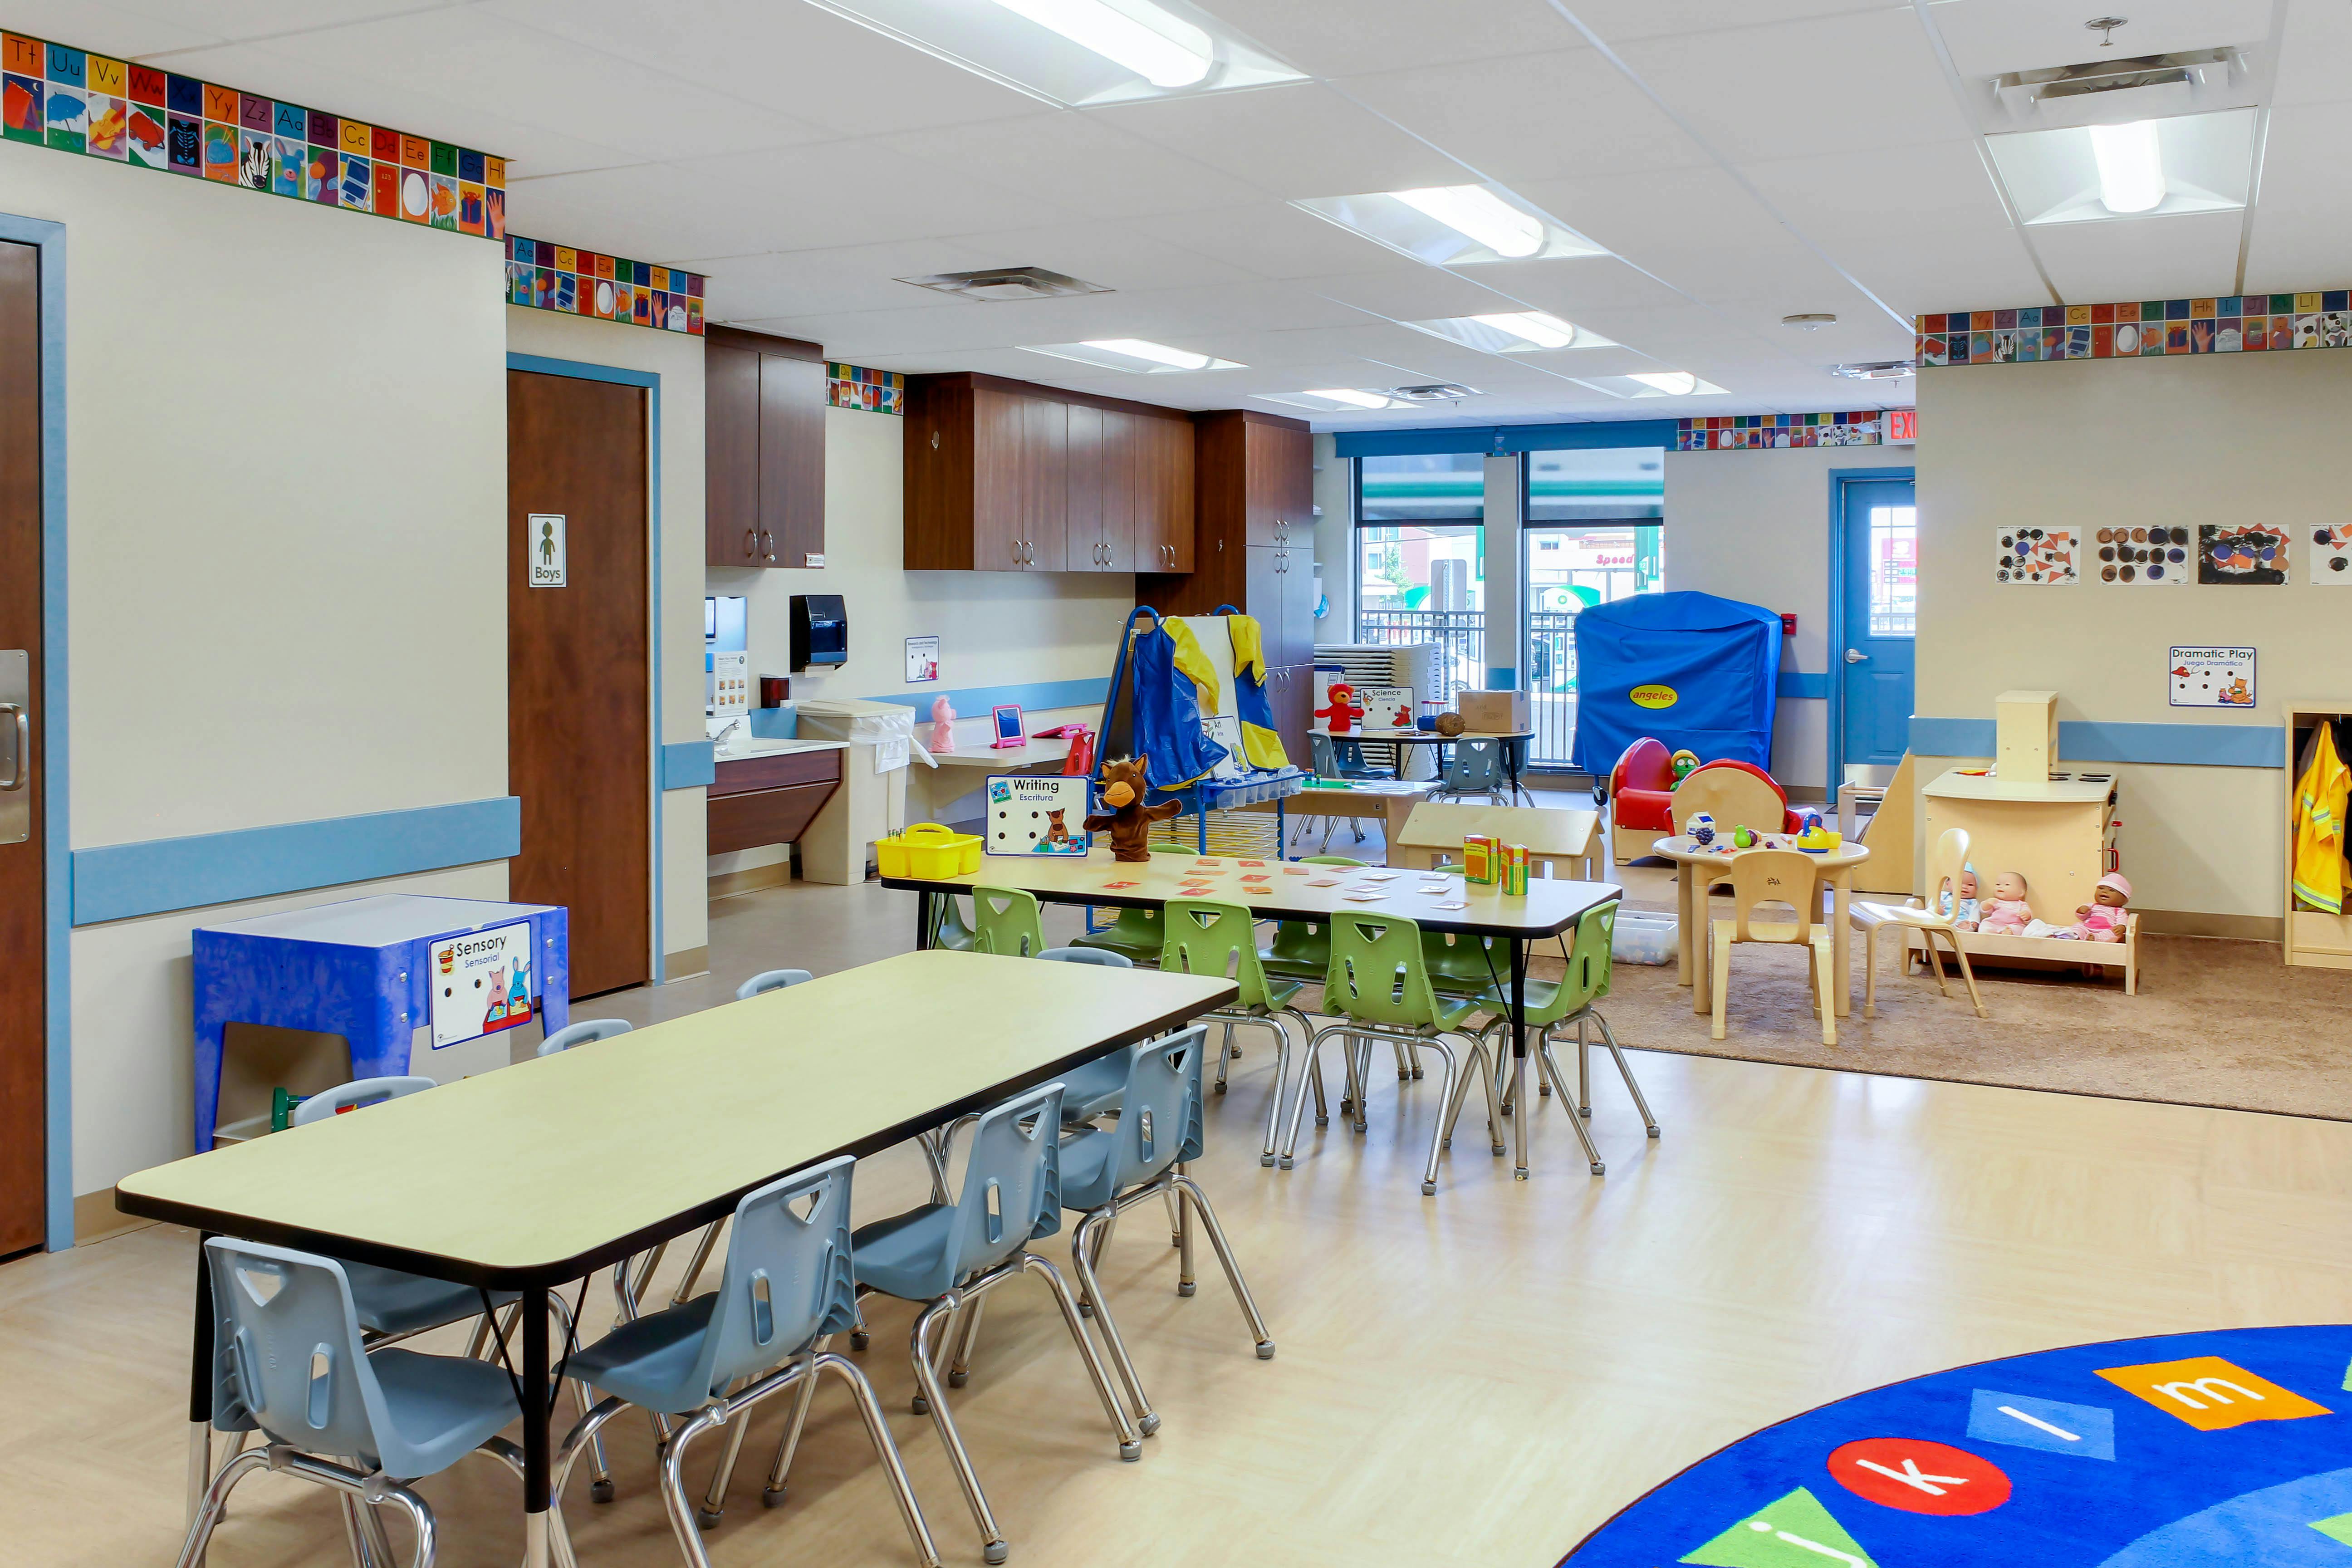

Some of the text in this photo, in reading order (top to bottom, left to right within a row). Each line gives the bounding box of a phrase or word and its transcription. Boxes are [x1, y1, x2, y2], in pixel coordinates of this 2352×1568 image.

[10, 39, 36, 65] Tt
[53, 50, 80, 76] Uu
[96, 60, 119, 85] Vv
[129, 70, 164, 96] Ww
[173, 80, 196, 104] Xx
[209, 89, 233, 122] Yy
[245, 98, 266, 122] Zz
[277, 109, 303, 131] Aa
[313, 116, 335, 138] Bb
[344, 125, 365, 146] Cc
[375, 131, 396, 153] Dd
[406, 139, 425, 160] Ee
[436, 147, 453, 165] Ff
[462, 154, 483, 182] Gg
[516, 242, 533, 257] Aa
[559, 250, 573, 265] Cc
[598, 257, 611, 273] Ee
[653, 269, 666, 284] Hh
[1975, 313, 1990, 329] Yy
[1998, 312, 2013, 324] Zz
[2020, 312, 2039, 323] Aa
[2070, 308, 2087, 319] Cc
[2120, 305, 2136, 317] Ee
[2194, 301, 2212, 313] Hh
[2225, 299, 2233, 312] Ii
[2300, 295, 2313, 307] Ll
[535, 566, 561, 582] Boys
[2172, 649, 2254, 660] Dramatic Play
[1633, 691, 1674, 701] angeles
[1214, 719, 1222, 729] Art
[1013, 779, 1059, 794] Writing
[456, 936, 508, 957] Sensory
[465, 952, 500, 969] Sensorial
[1855, 1457, 1971, 1496] k
[2151, 1376, 2265, 1410] m
